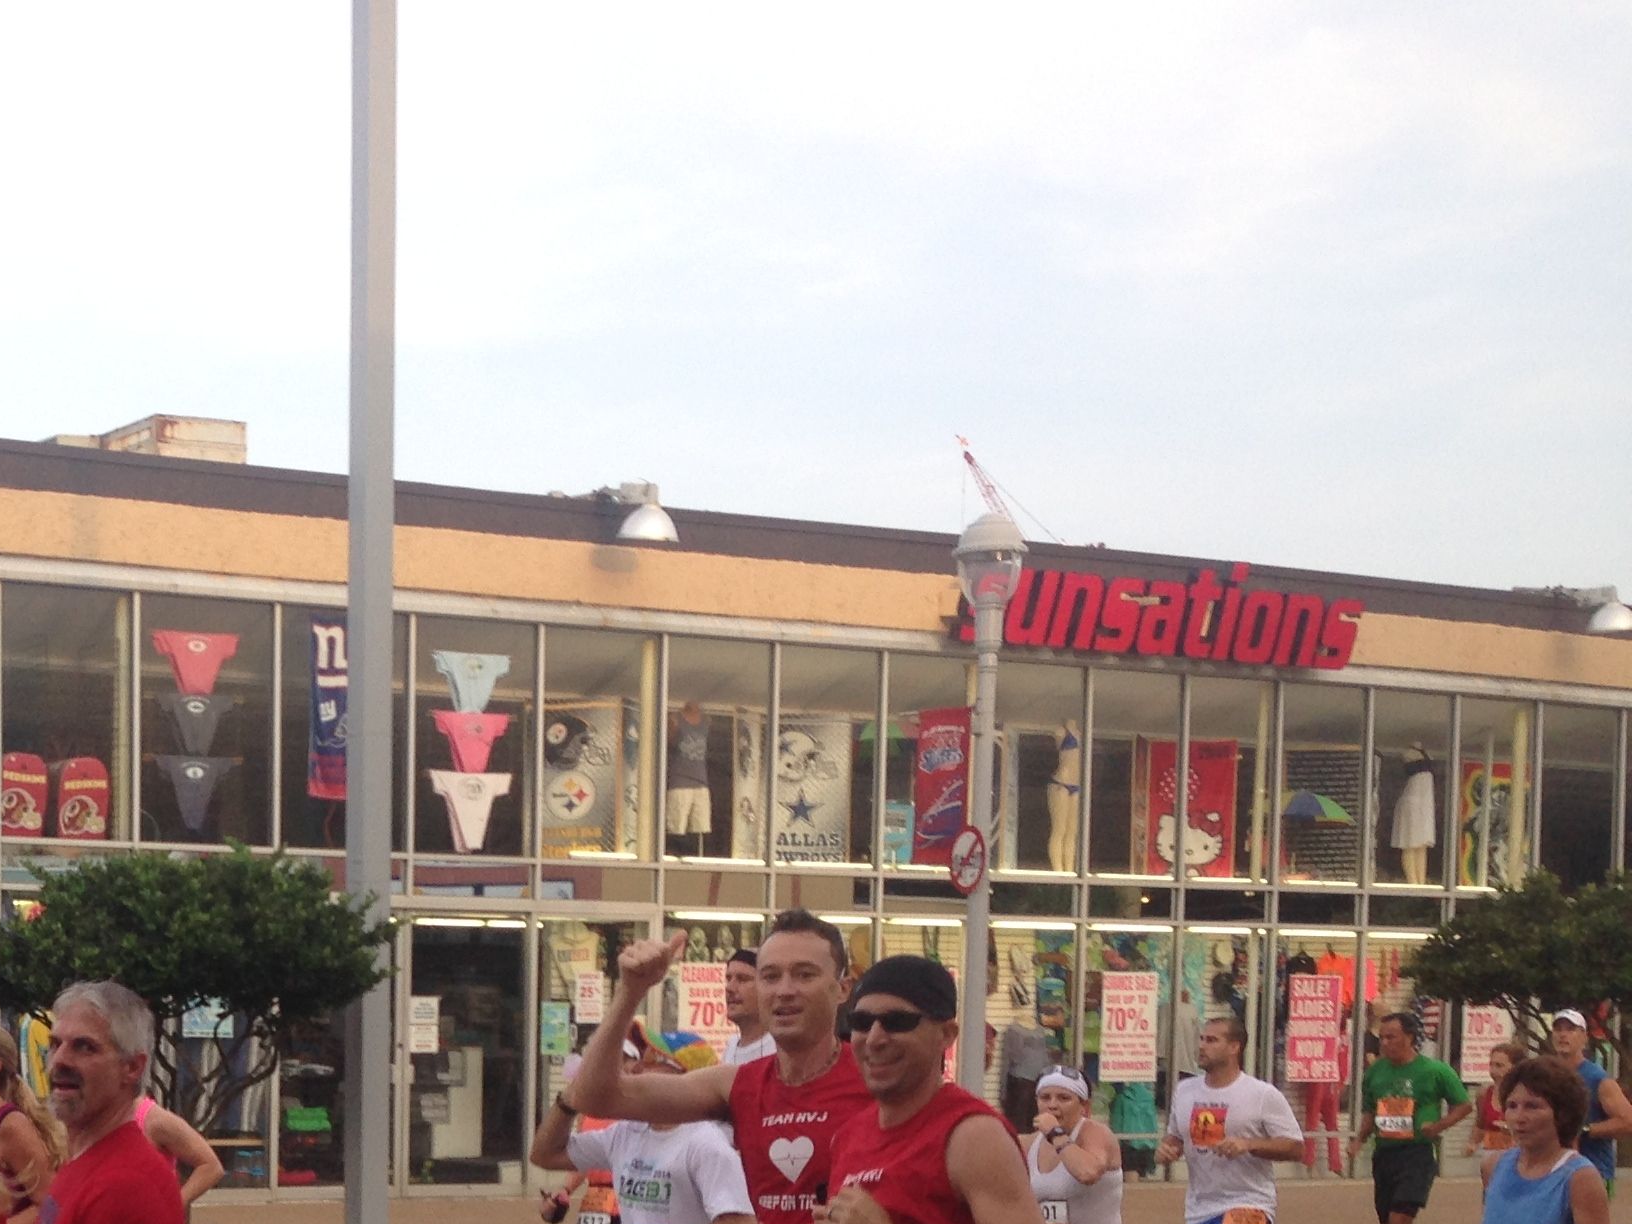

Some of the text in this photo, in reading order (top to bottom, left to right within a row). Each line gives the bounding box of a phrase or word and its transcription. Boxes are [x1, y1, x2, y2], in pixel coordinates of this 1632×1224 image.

[775, 832, 841, 847] ALLAS
[688, 987, 711, 999] SAVE
[1106, 1007, 1149, 1031] 70%
[762, 1113, 795, 1128] TEAM
[798, 1195, 818, 1211] TIC
[1041, 1204, 1057, 1220] 01
